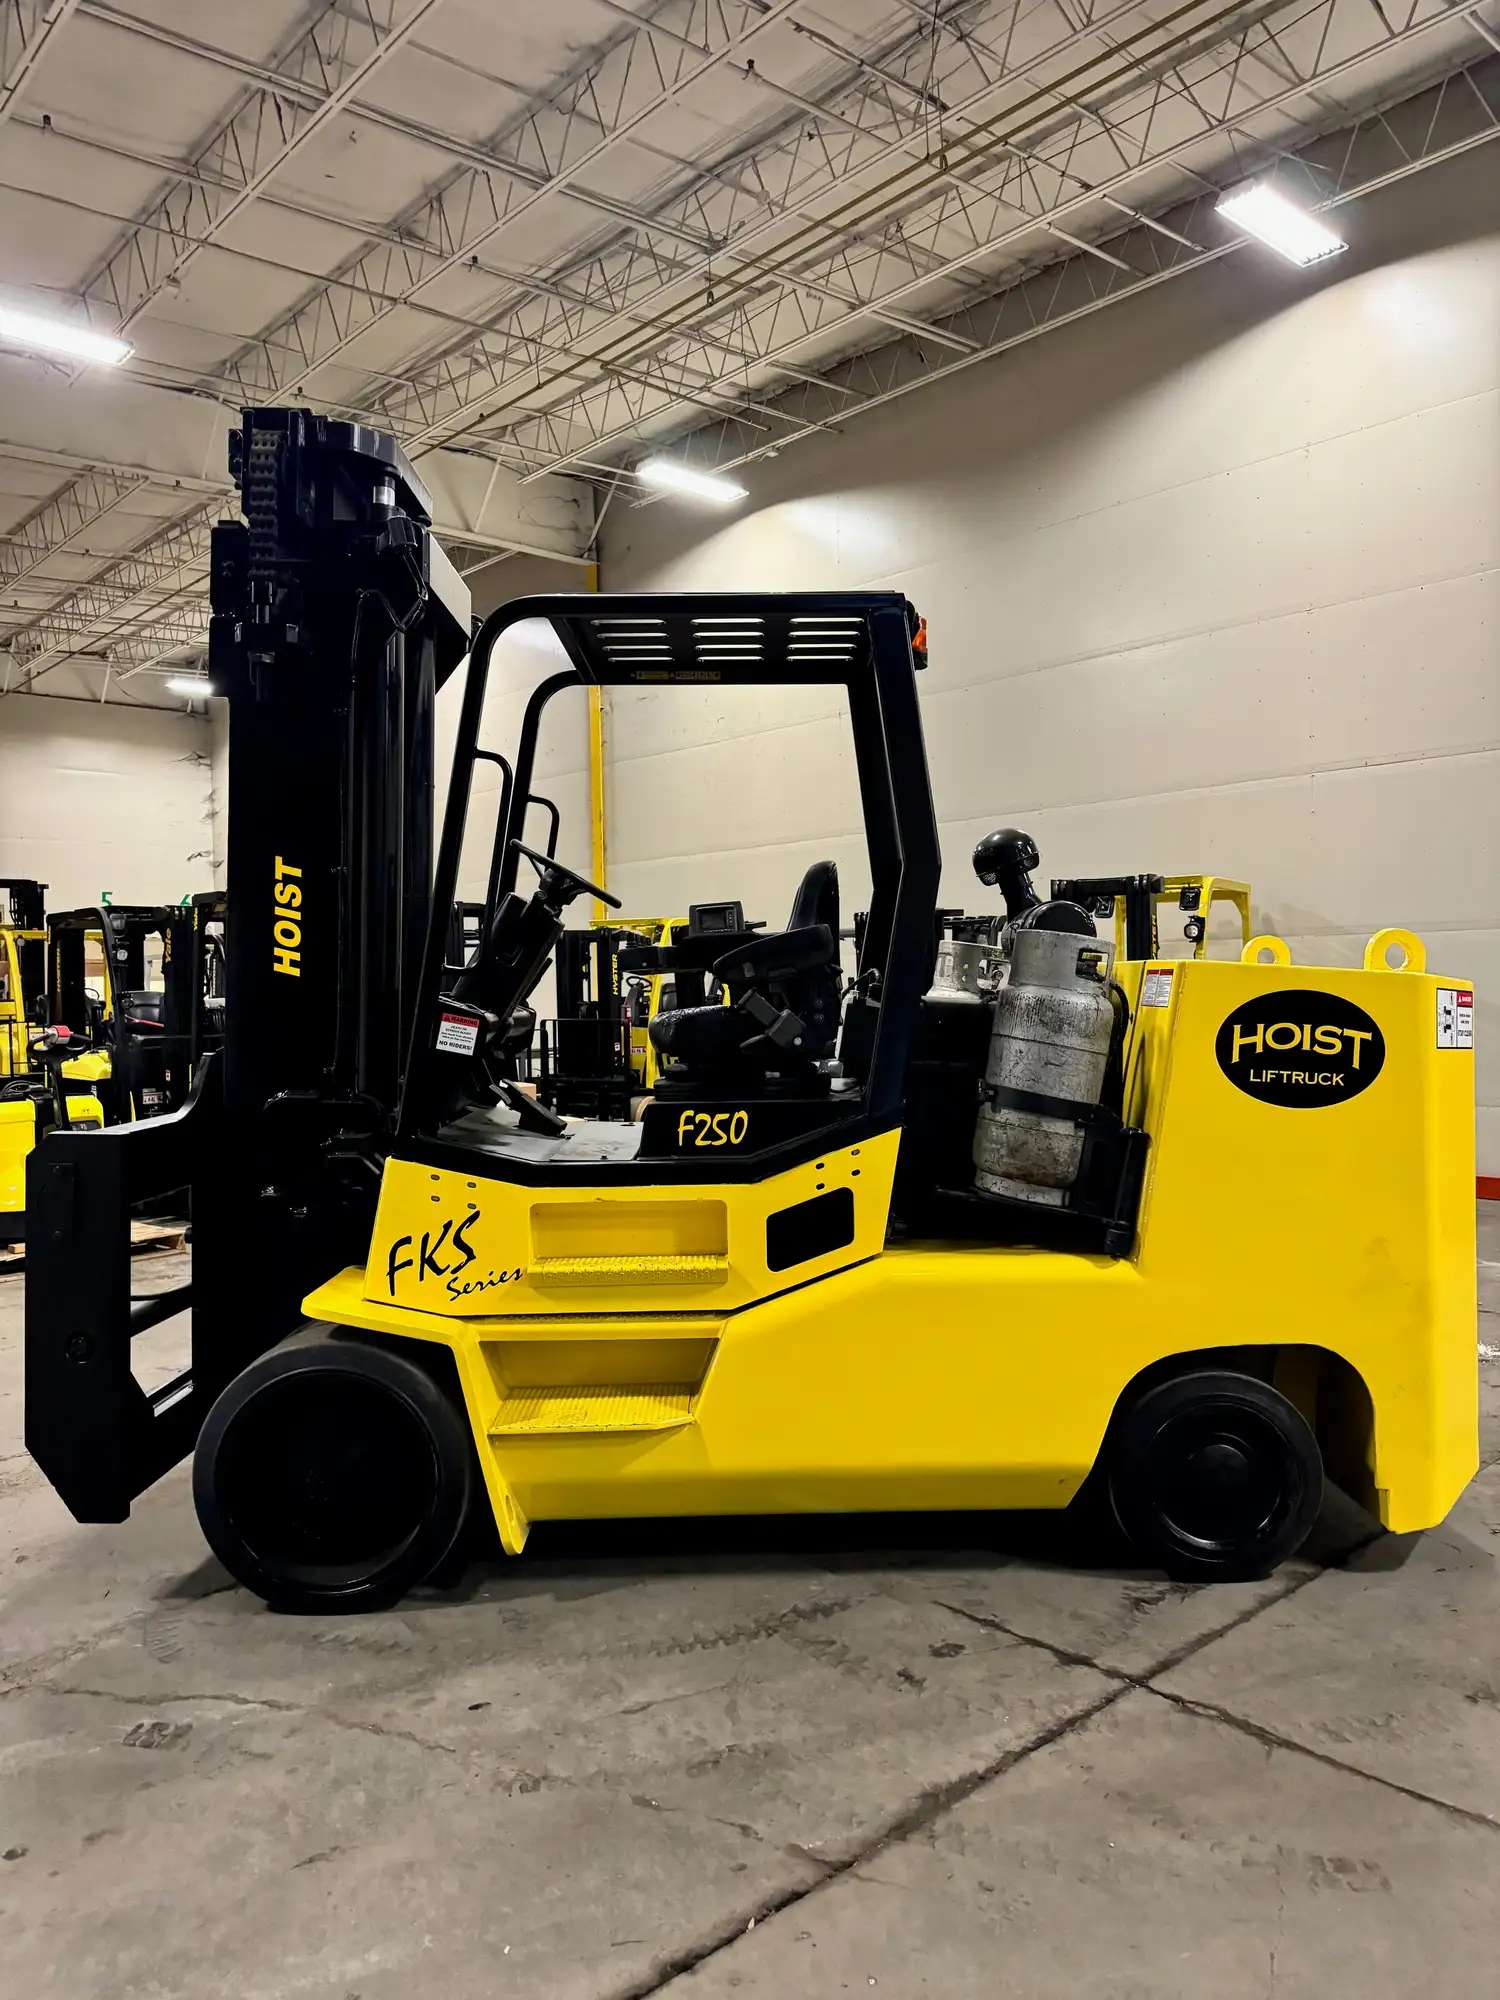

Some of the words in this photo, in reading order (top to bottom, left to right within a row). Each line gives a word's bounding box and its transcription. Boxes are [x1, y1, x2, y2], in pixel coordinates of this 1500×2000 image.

[101, 891, 113, 906] 5
[273, 855, 302, 978] HOIST
[611, 954, 619, 996] HYSTER
[1231, 1022, 1373, 1070] HOIST
[1249, 1069, 1345, 1086] LIFTRUCK
[677, 1109, 749, 1147] F250
[386, 1210, 481, 1297] FKS
[446, 1268, 524, 1301] Series
